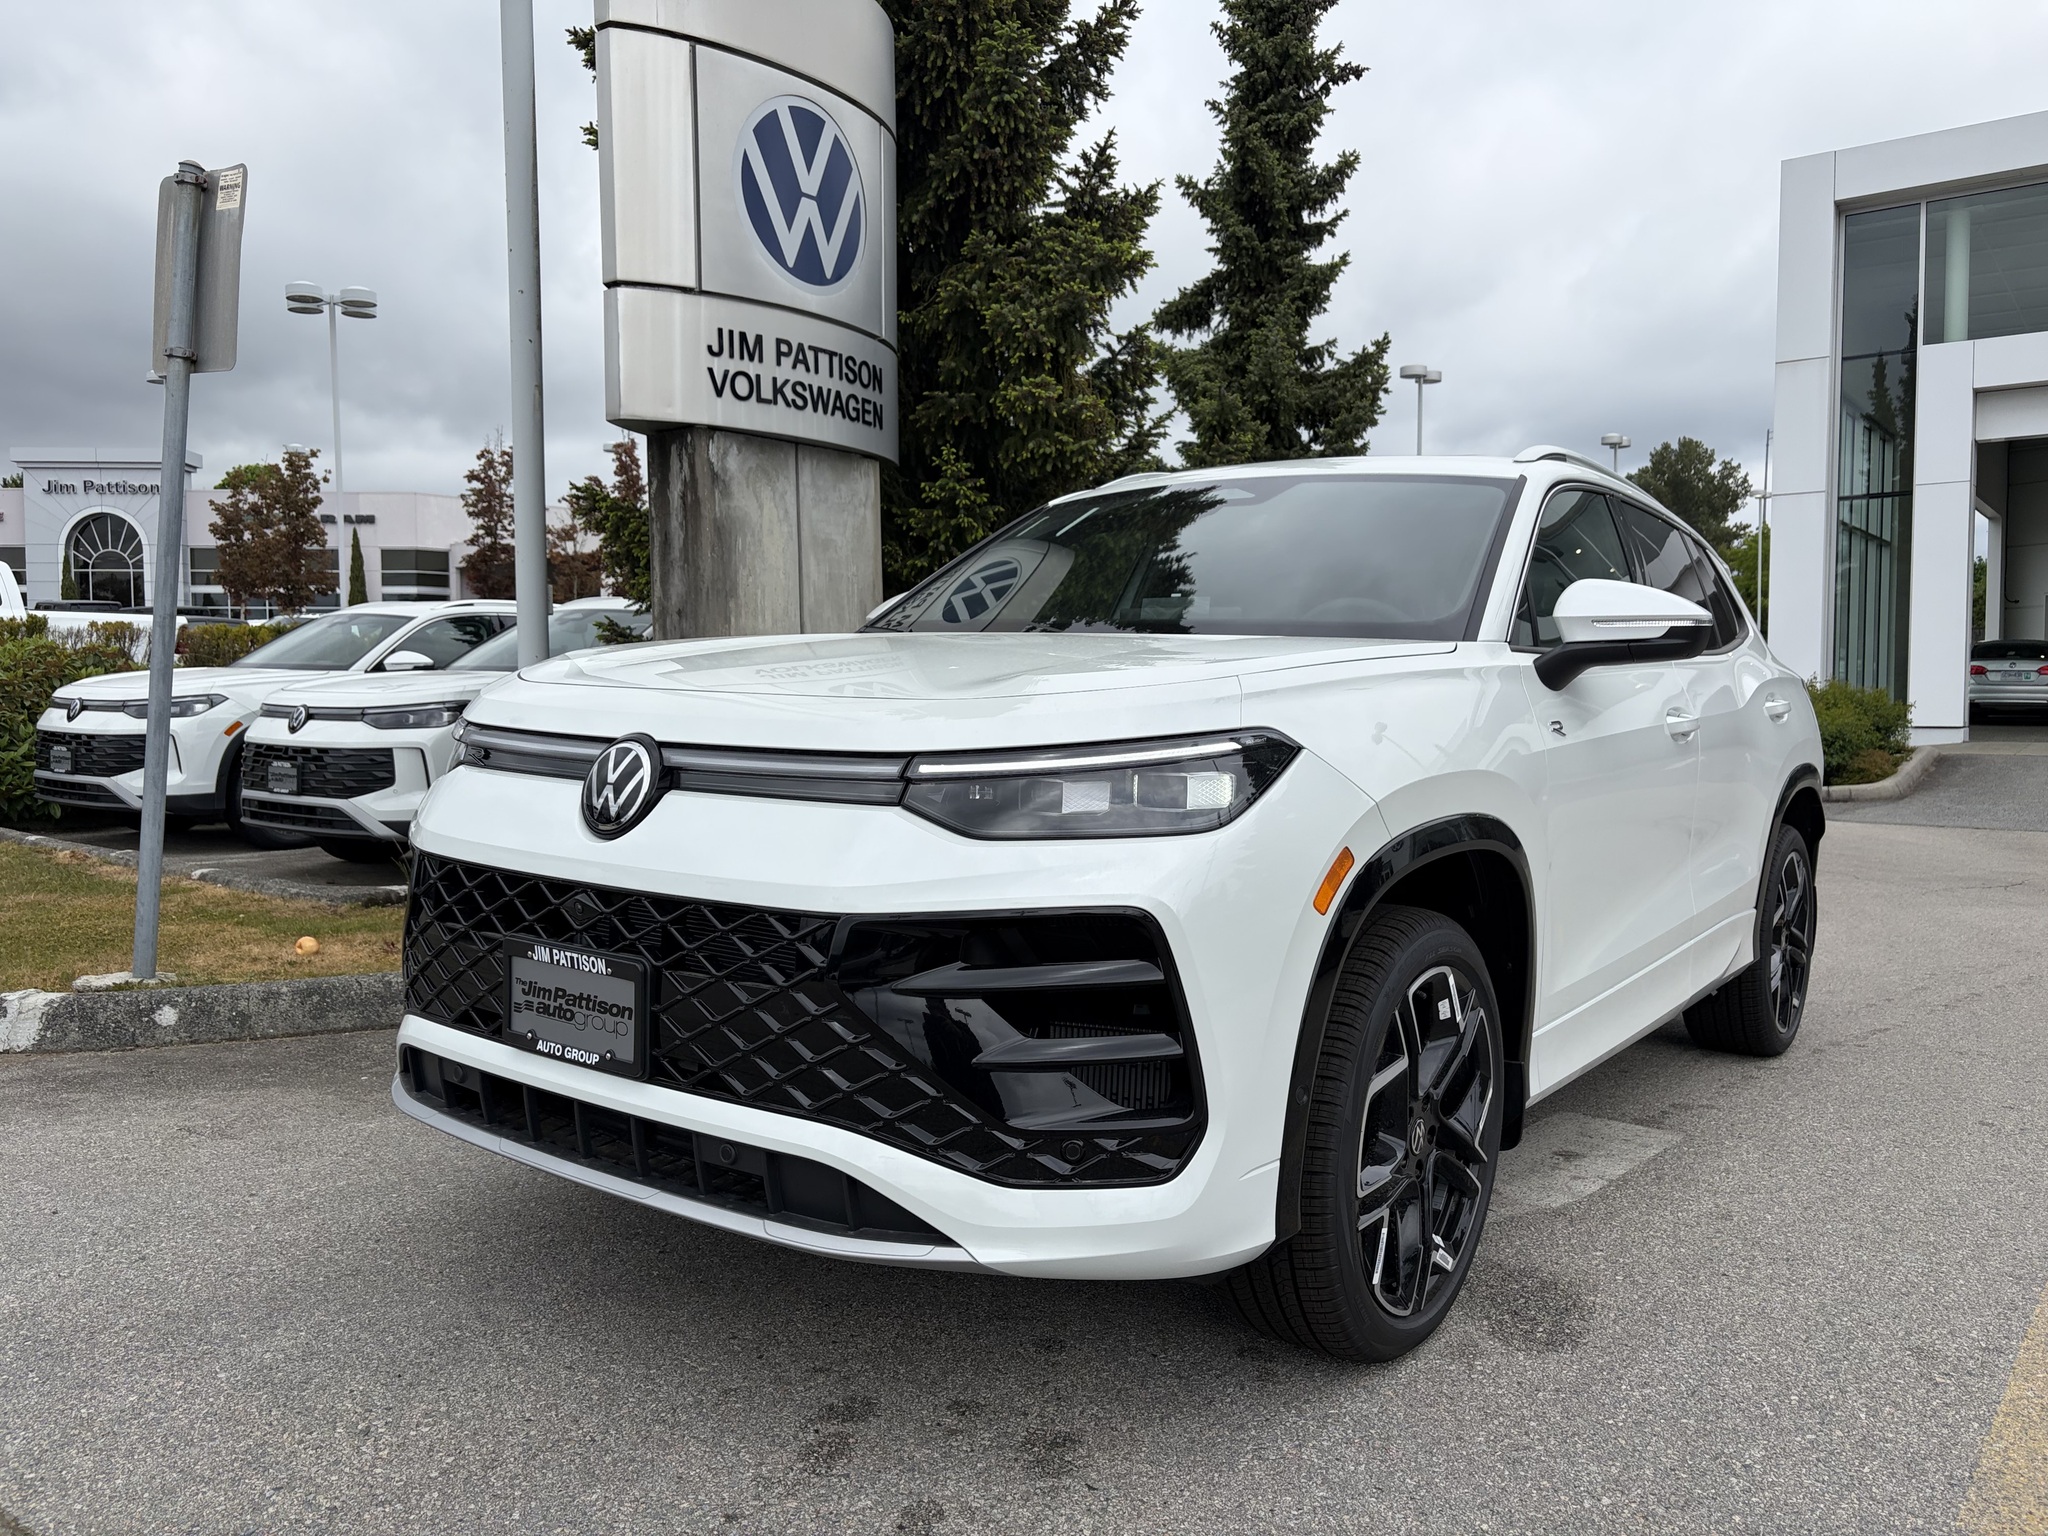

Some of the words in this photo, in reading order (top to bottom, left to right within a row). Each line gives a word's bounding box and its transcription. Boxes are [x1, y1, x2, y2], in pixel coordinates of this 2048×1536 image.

[707, 327, 763, 363] JIM
[776, 337, 883, 395] PATTISON
[707, 367, 883, 430] VOLKSWAGEN
[42, 480, 77, 495] Jim
[83, 480, 160, 495] Pattison
[532, 944, 551, 963] JIM
[552, 948, 607, 975] PATTISON
[515, 977, 528, 987] The
[536, 1039, 562, 1057] AUTO
[564, 1047, 600, 1065] GROUP
